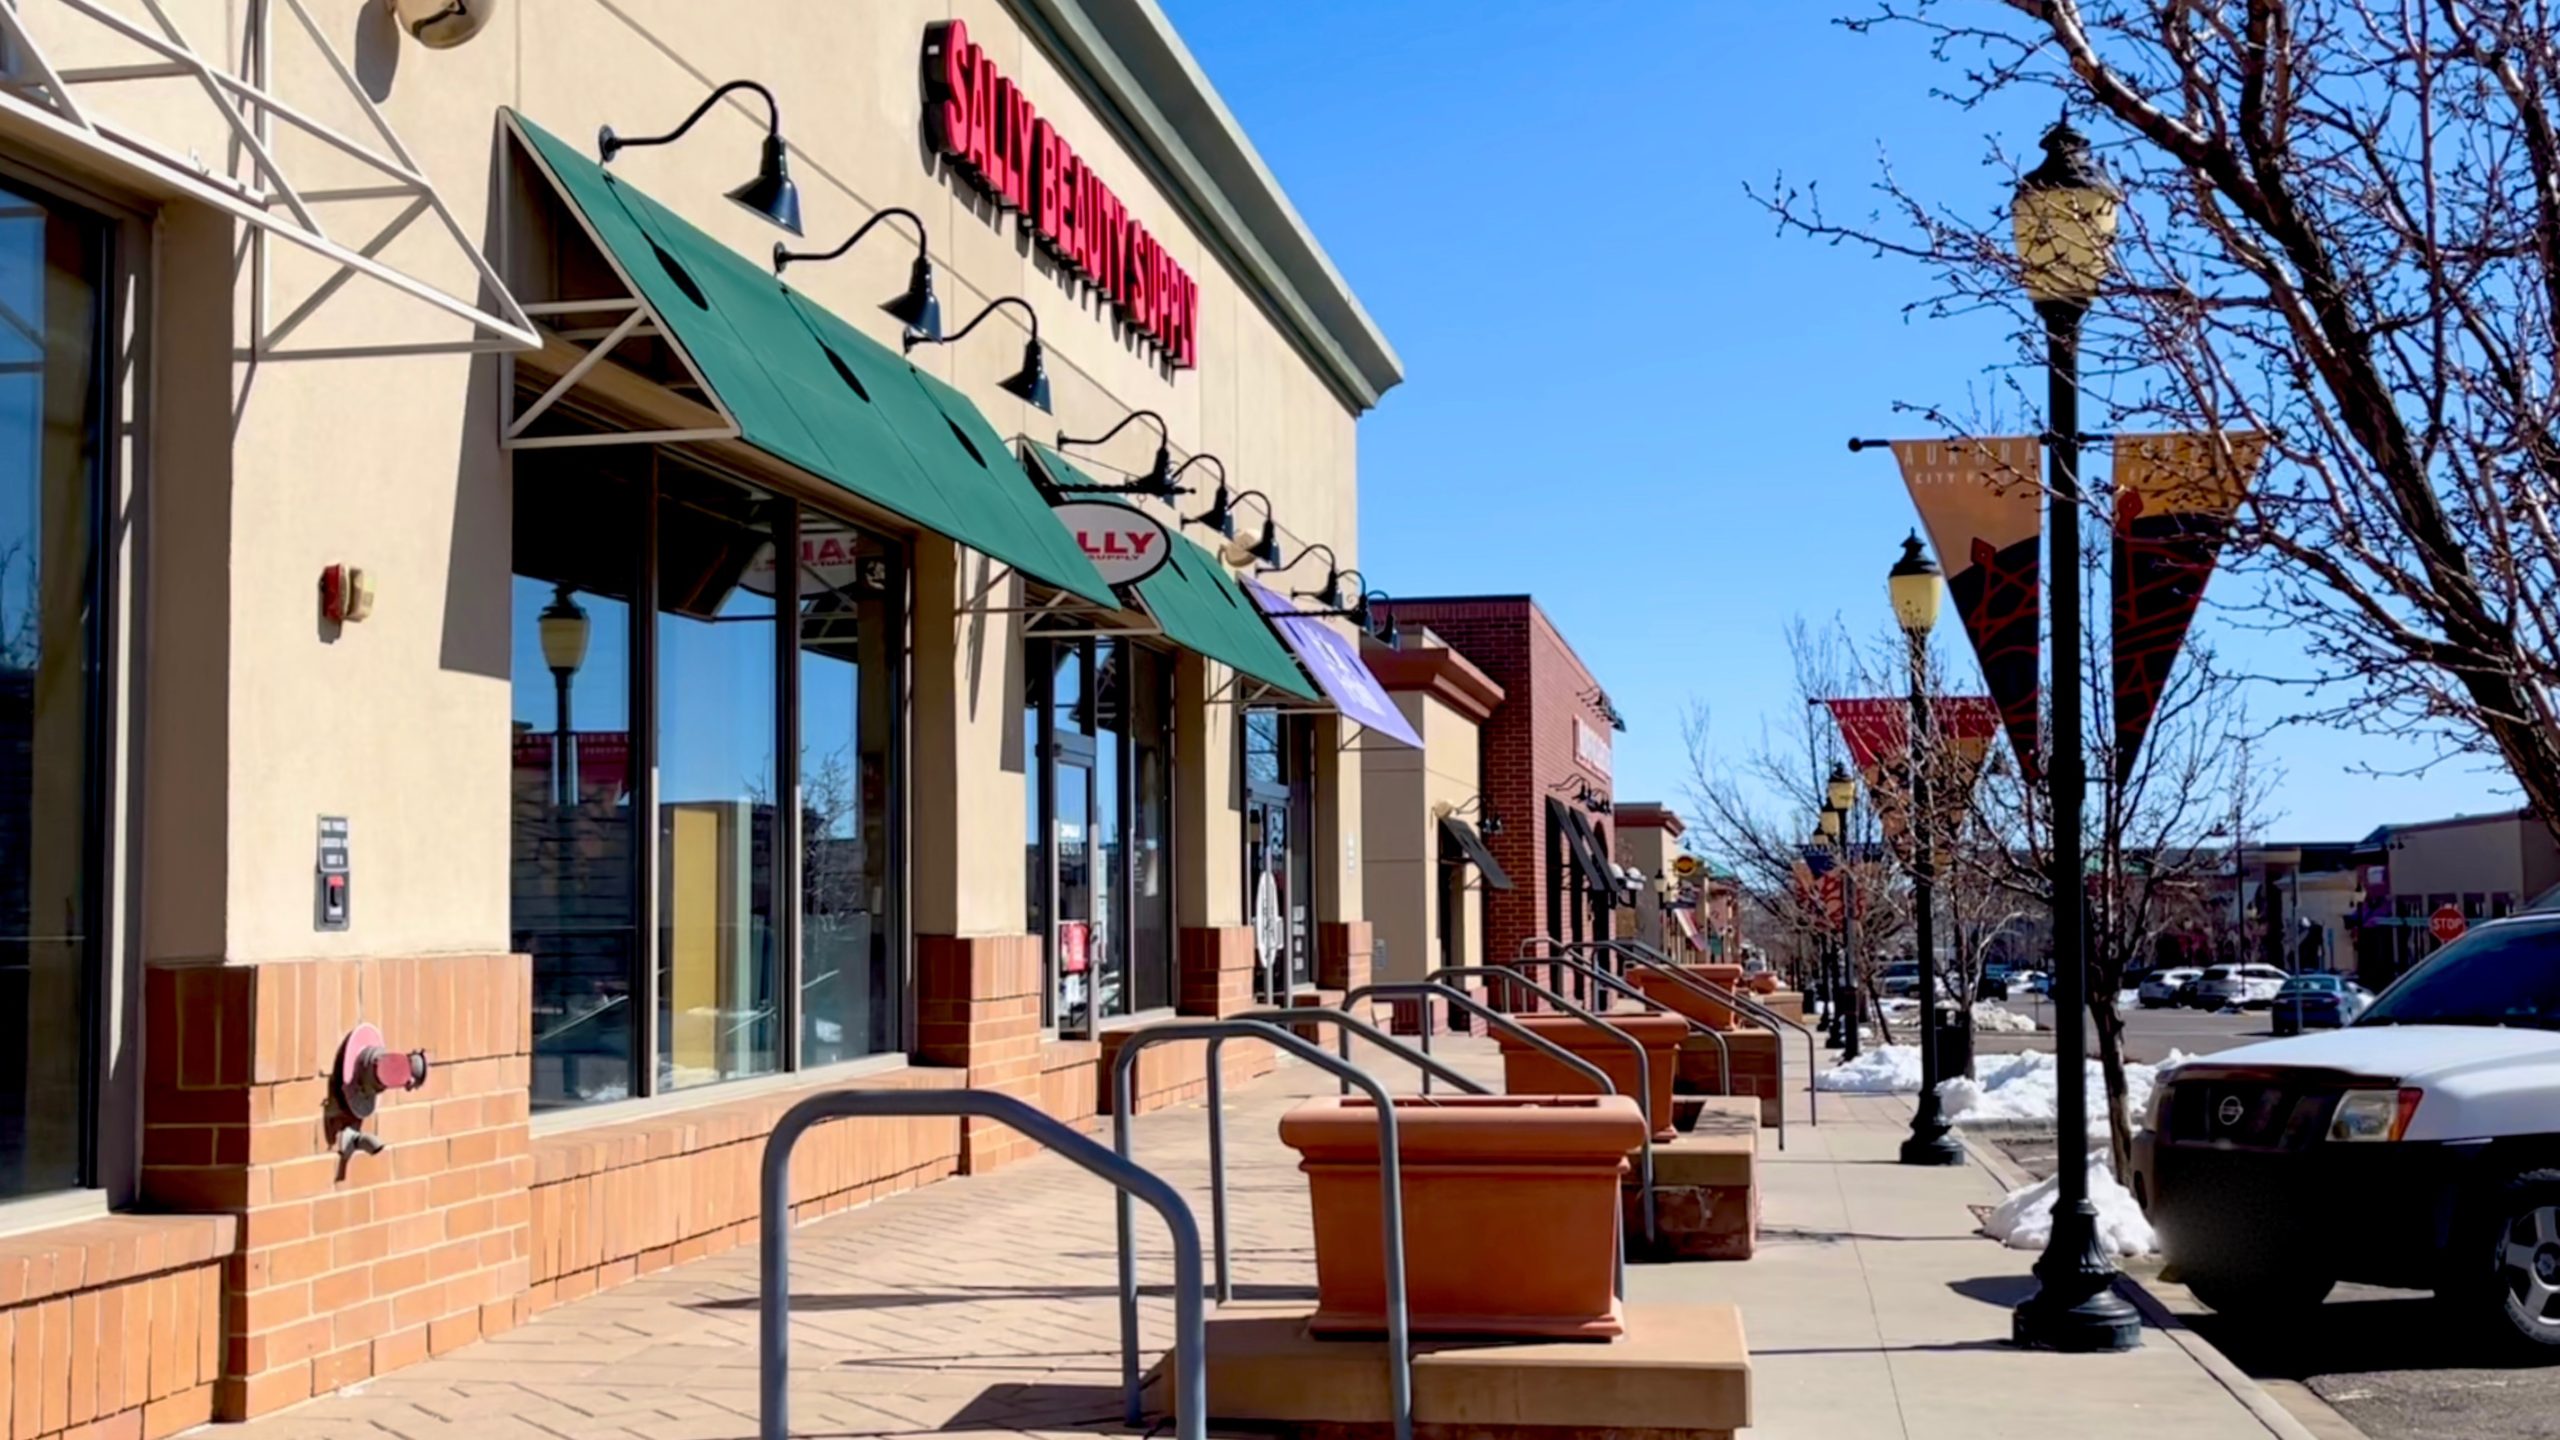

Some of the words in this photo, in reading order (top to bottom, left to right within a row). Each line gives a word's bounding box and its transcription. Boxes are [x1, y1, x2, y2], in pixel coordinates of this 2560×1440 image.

[944, 19, 1035, 215] SALLY
[1037, 119, 1129, 306] BEAUTY
[1132, 219, 1198, 371] SUPPLY
[1076, 531, 1156, 554] LLY
[2432, 917, 2463, 931] STOP
